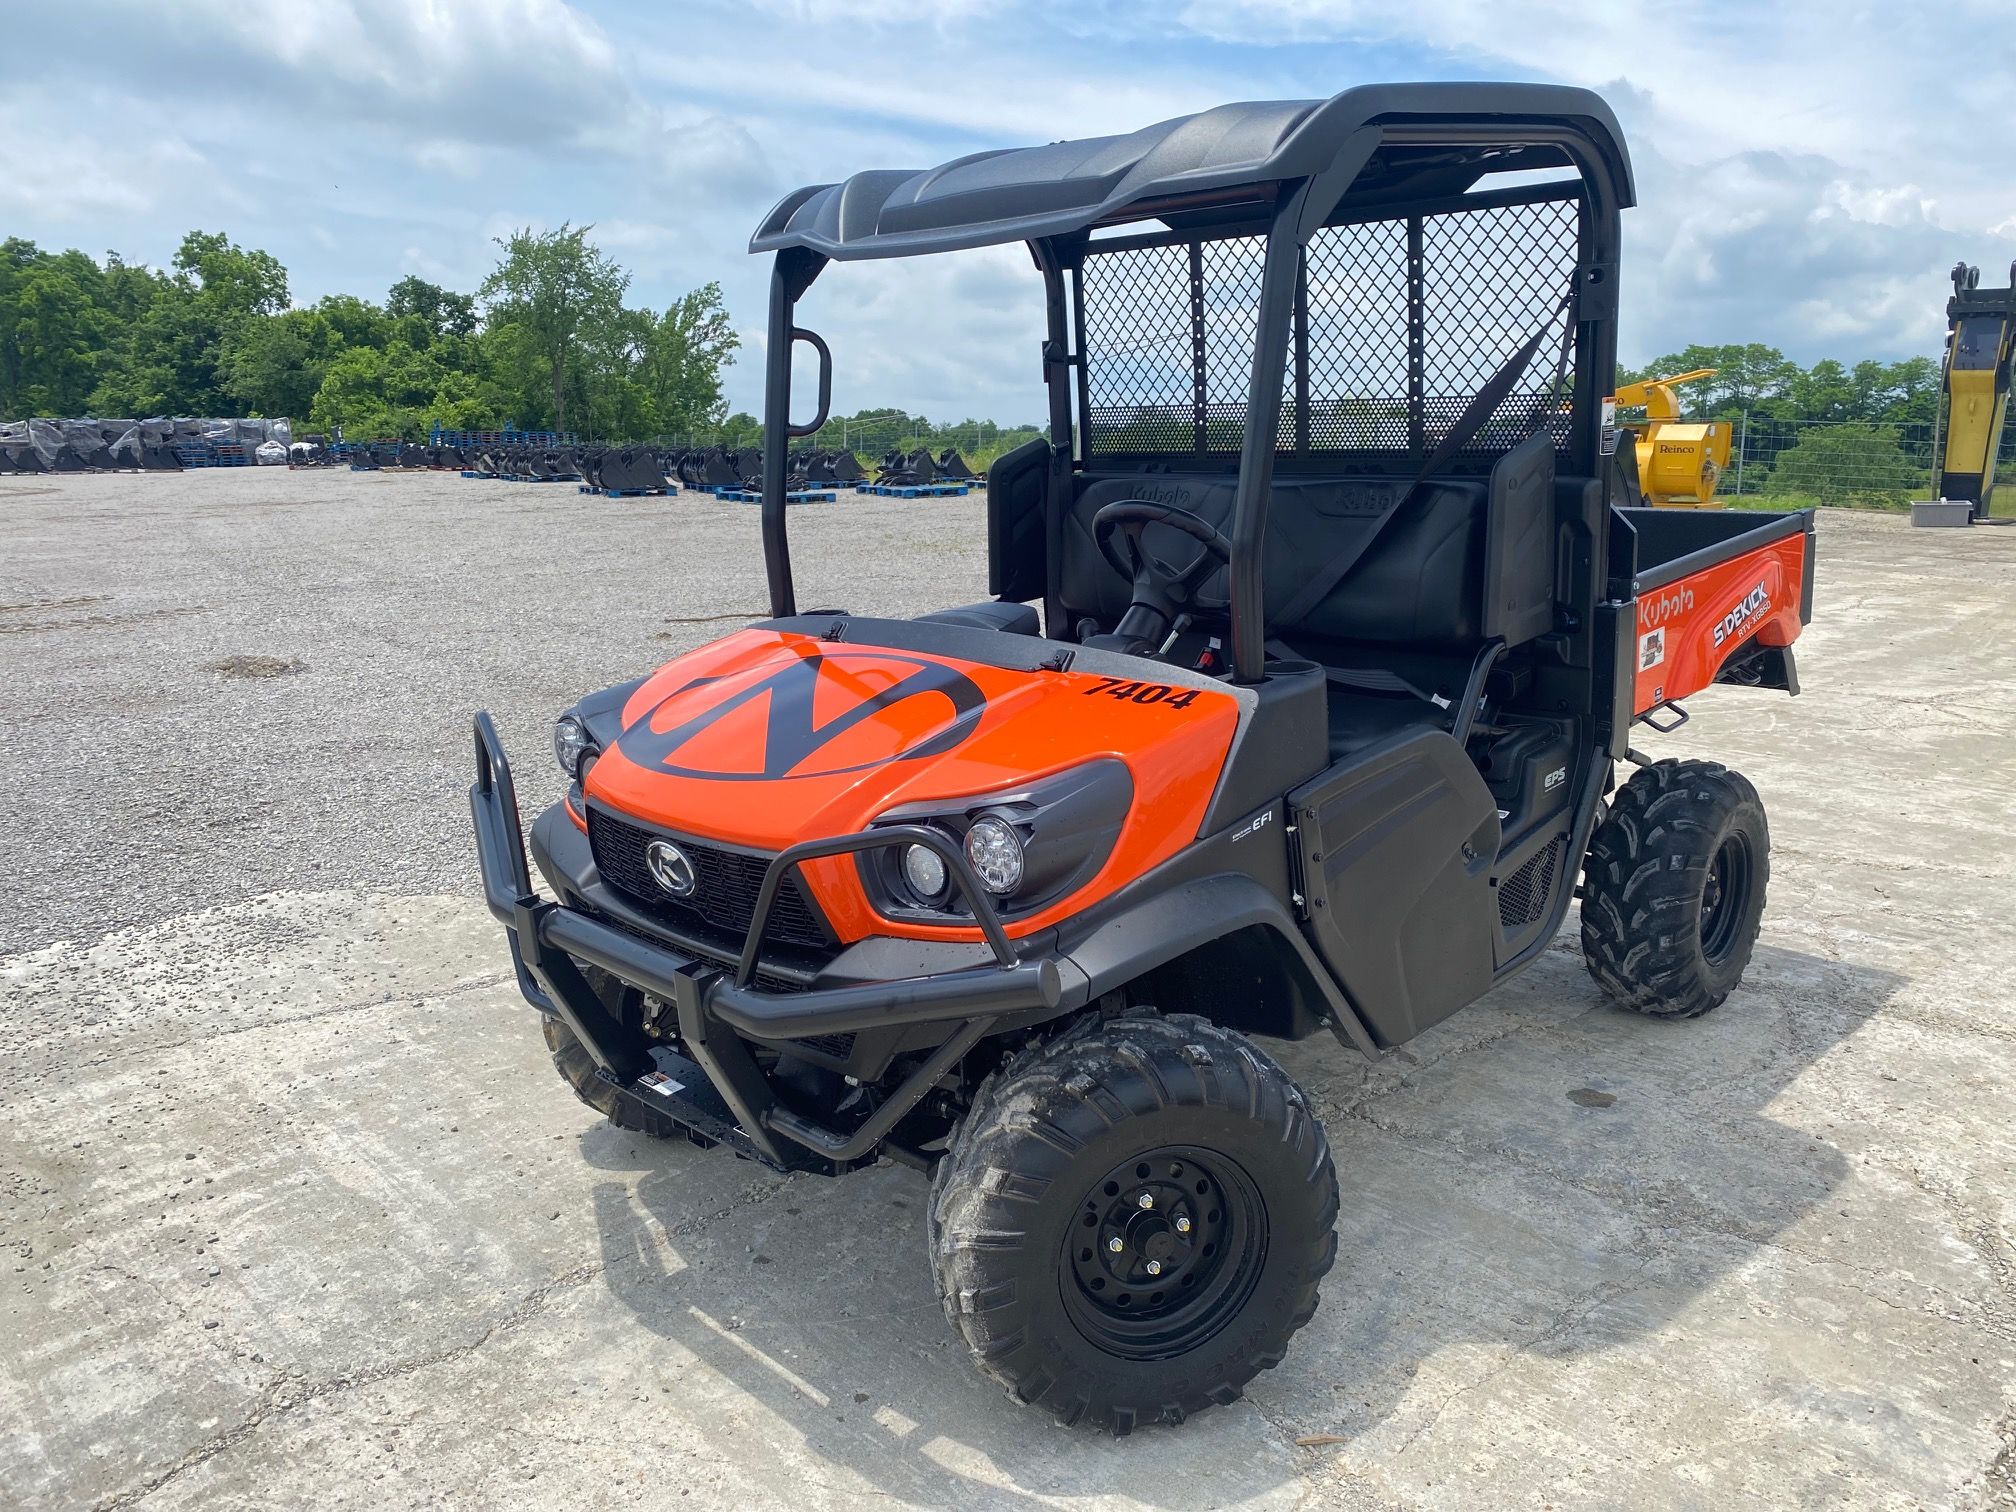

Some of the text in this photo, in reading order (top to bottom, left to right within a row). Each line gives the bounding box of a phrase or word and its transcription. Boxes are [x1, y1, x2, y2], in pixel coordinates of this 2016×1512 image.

[1659, 444, 1695, 454] Reinco
[1640, 585, 1694, 628] Kubota
[1713, 579, 1769, 649] SIDEKICK
[1082, 677, 1202, 710] 7404
[1544, 766, 1566, 788] EPS
[1252, 810, 1272, 831] EFI
